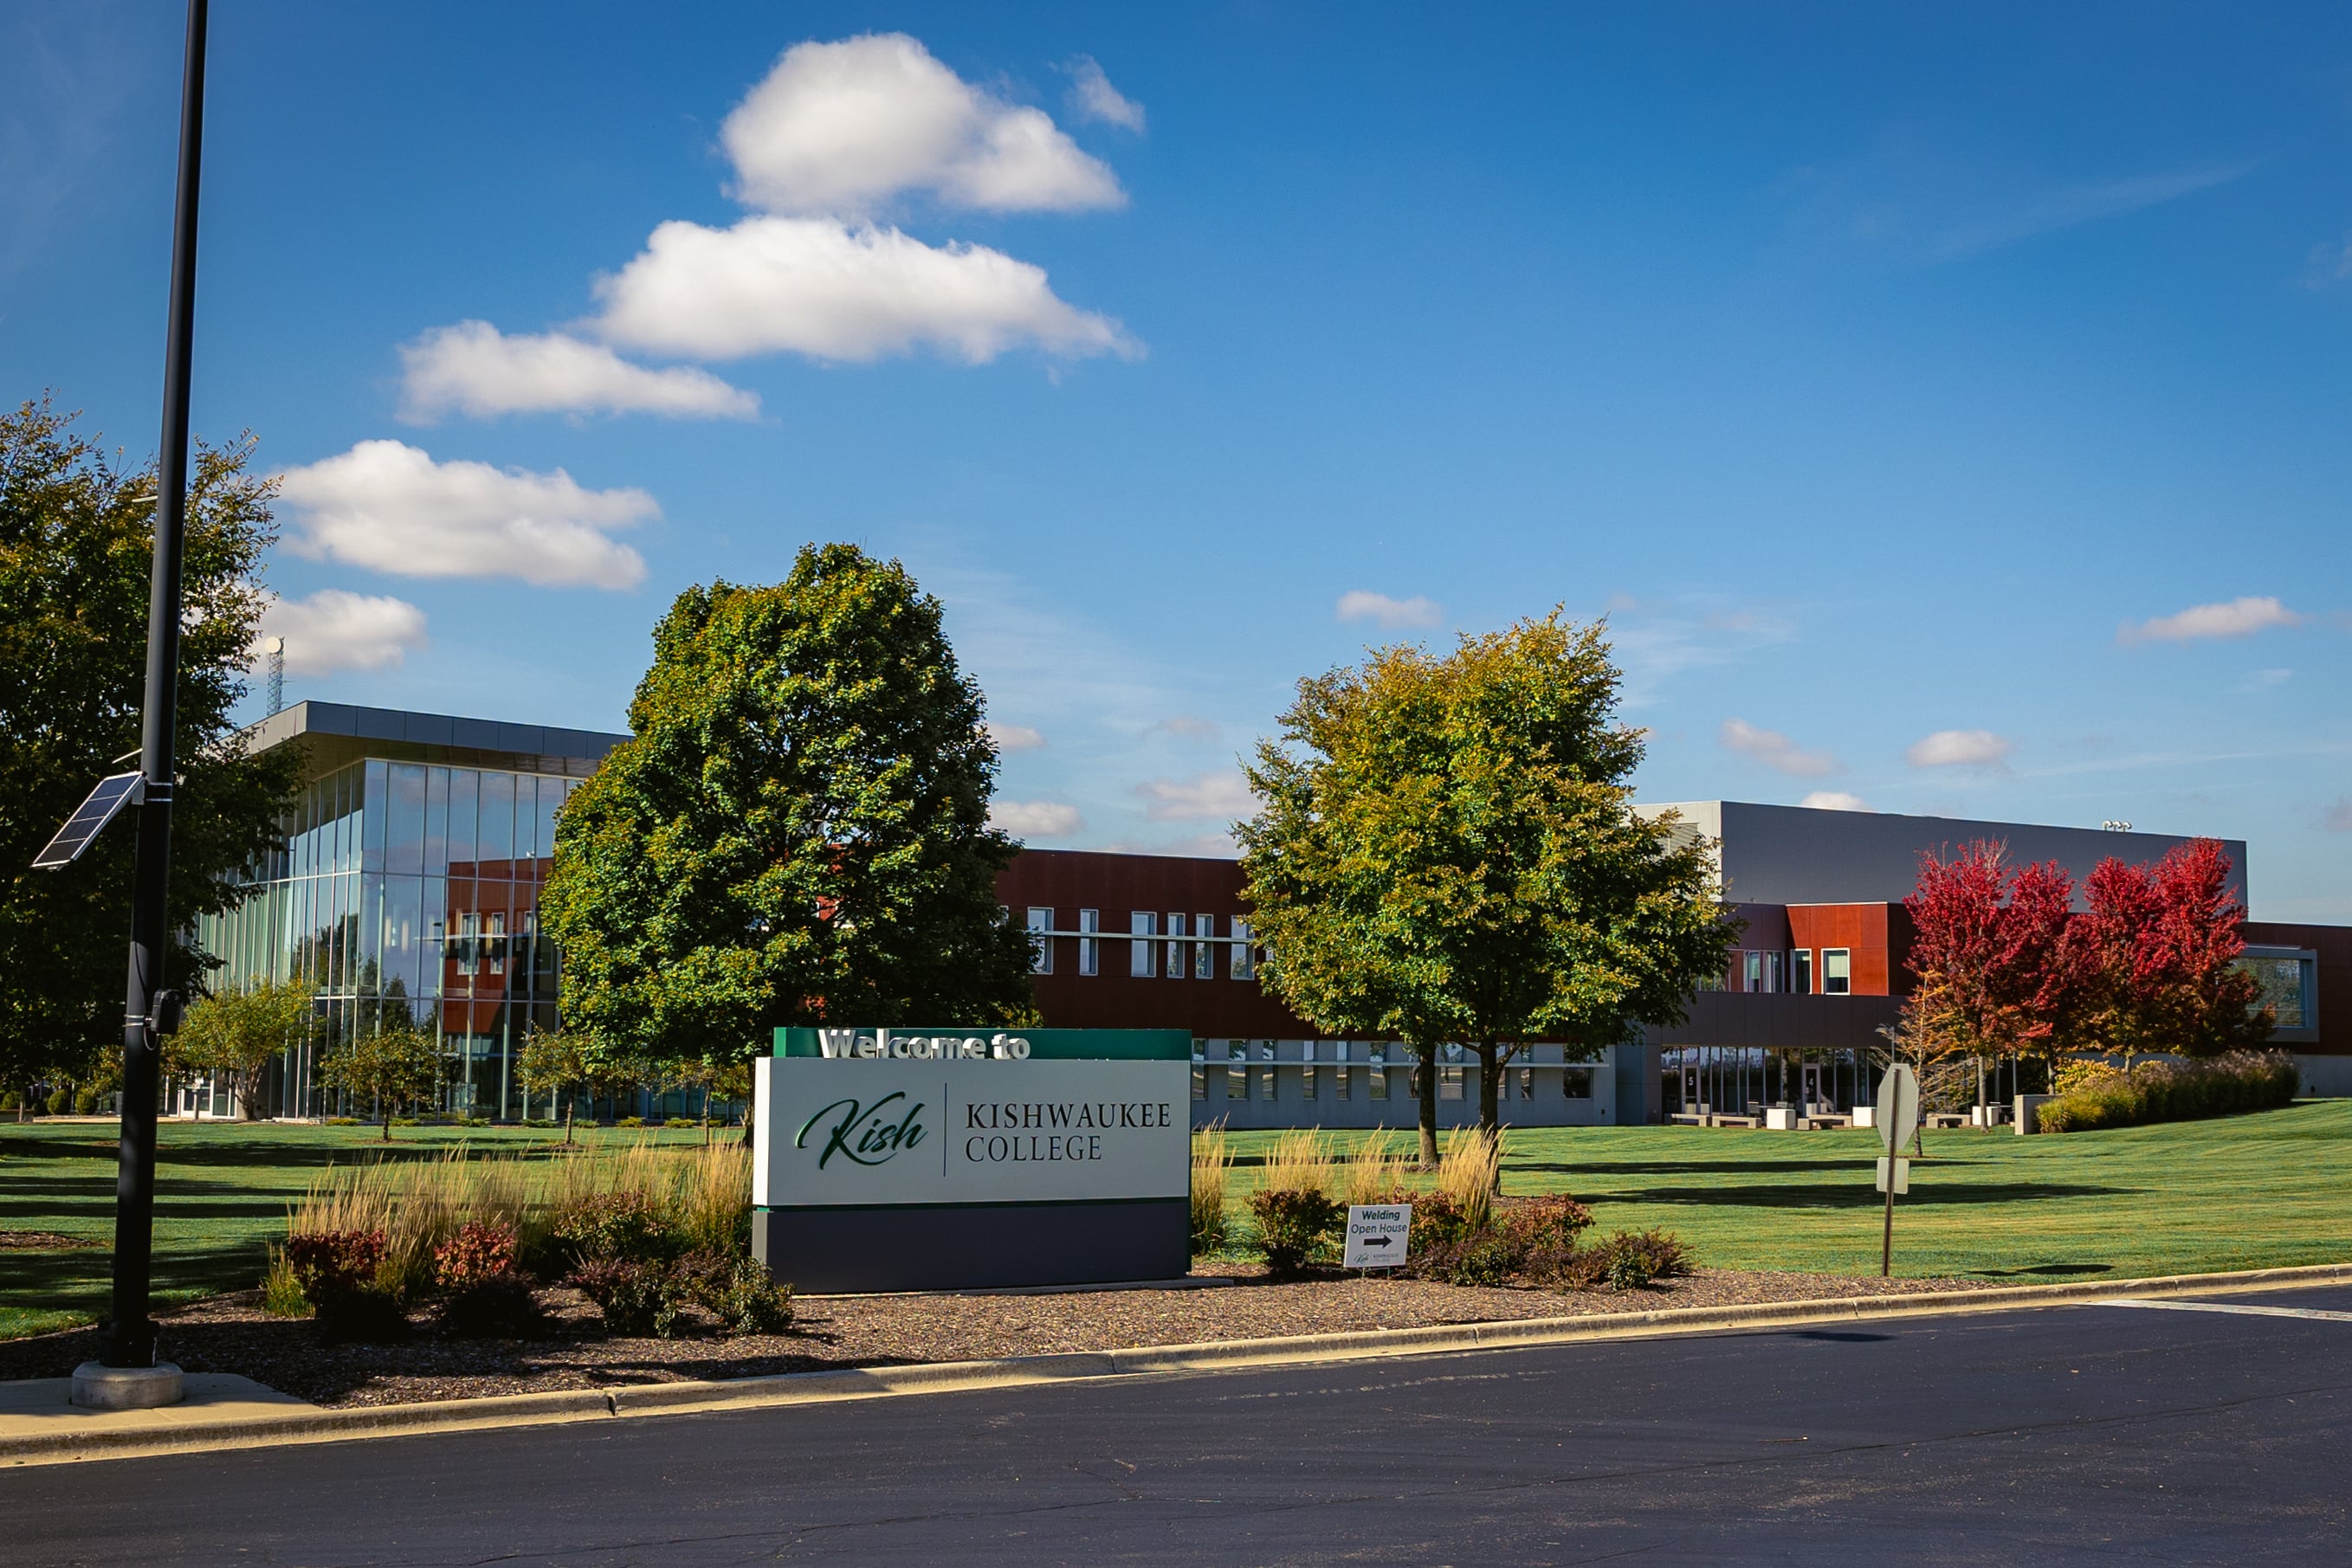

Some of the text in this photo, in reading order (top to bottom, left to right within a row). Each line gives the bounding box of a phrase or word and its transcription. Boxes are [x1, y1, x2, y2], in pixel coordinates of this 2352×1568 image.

[818, 1029, 1031, 1060] Welcome to
[1688, 1076, 1694, 1086] 5
[966, 1102, 1172, 1129] KISHWAUKEE
[795, 1091, 928, 1171] Kish
[966, 1135, 1102, 1162] COLLEGE
[1351, 1223, 1407, 1235] Open House
[1361, 1210, 1400, 1222] Welding
